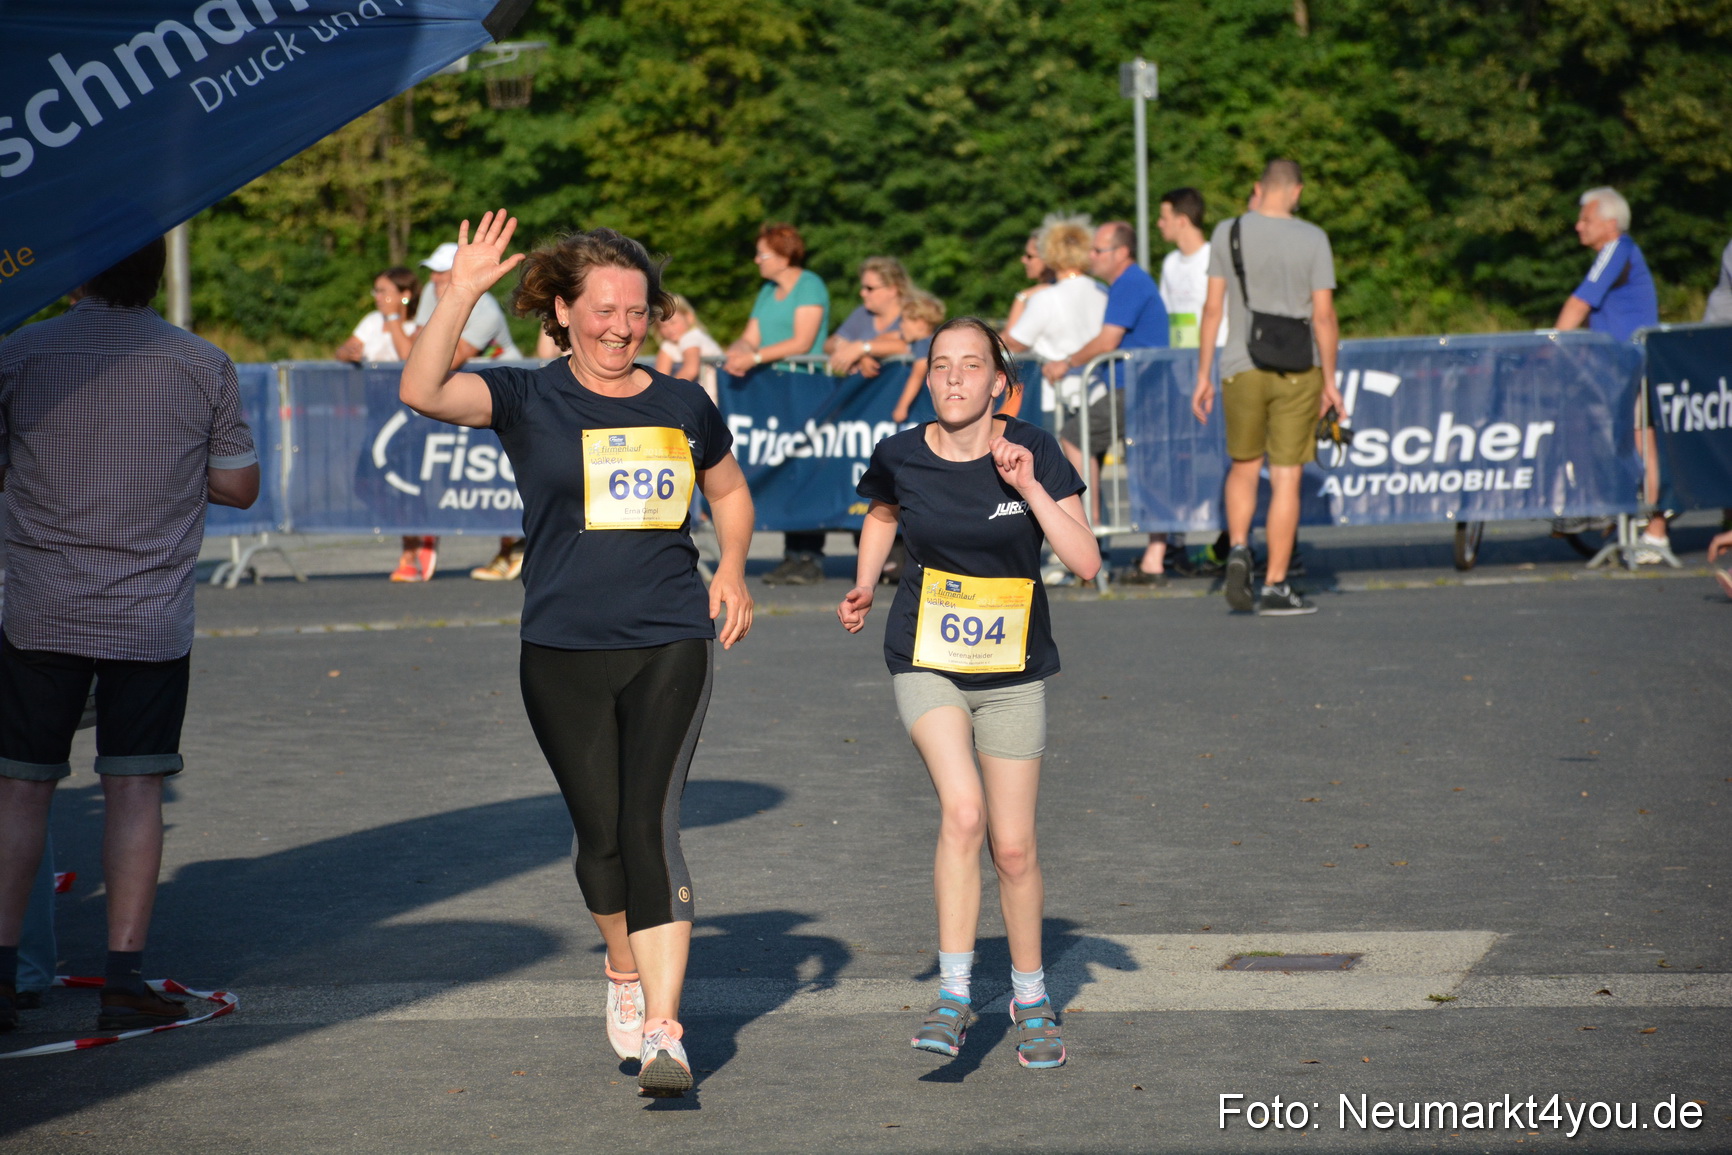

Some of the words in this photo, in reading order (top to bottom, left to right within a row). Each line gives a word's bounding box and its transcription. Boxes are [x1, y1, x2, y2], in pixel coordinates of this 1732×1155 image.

[189, 31, 306, 113] Druck
[308, 0, 386, 43] und
[1655, 376, 1732, 433] Frisch
[1317, 411, 1555, 468] ischer
[590, 457, 623, 465] walken
[608, 468, 675, 500] 686
[1317, 467, 1534, 498] AUTOMOBILE
[926, 597, 957, 609] walken
[937, 587, 976, 600] firmenlauf
[940, 613, 1006, 647] 694
[948, 651, 972, 659] Verena
